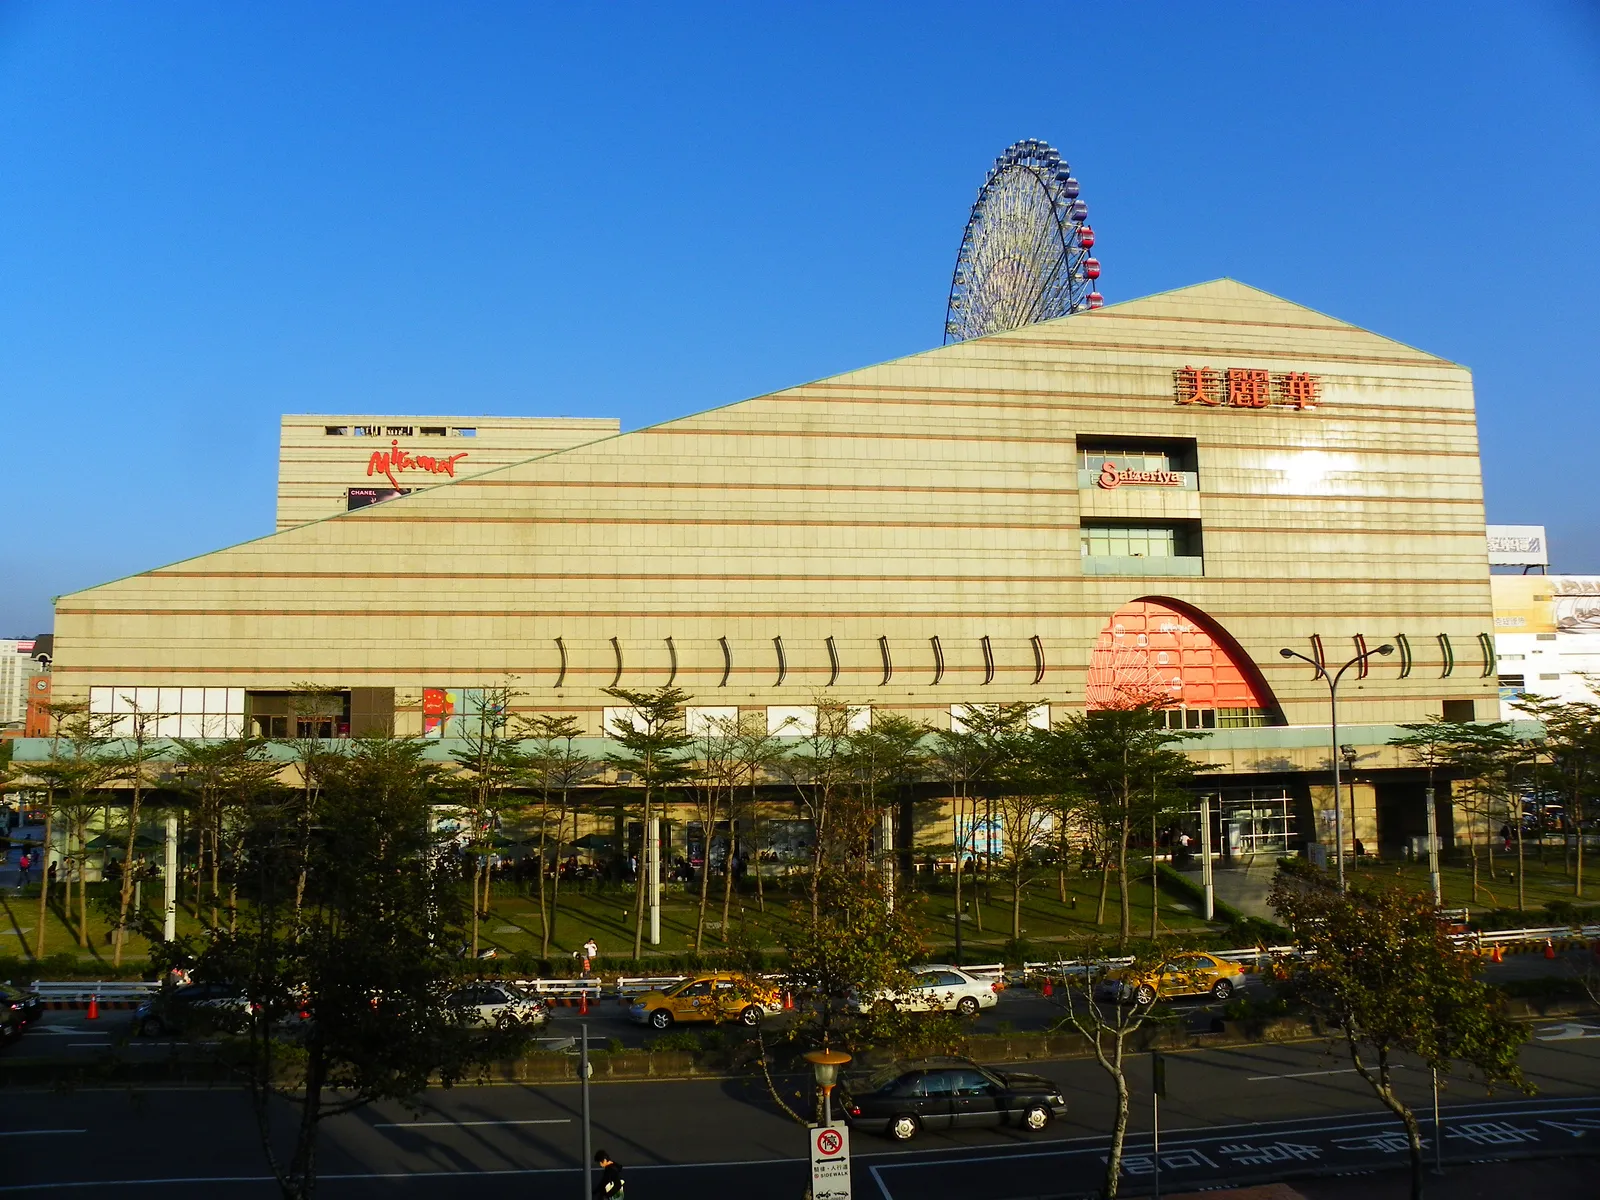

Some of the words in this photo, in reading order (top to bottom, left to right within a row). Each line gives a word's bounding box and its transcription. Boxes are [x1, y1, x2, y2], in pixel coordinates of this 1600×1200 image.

[1176, 365, 1322, 410] 美麗華
[367, 439, 468, 491] Miramar
[1098, 461, 1180, 489] Saizeriya
